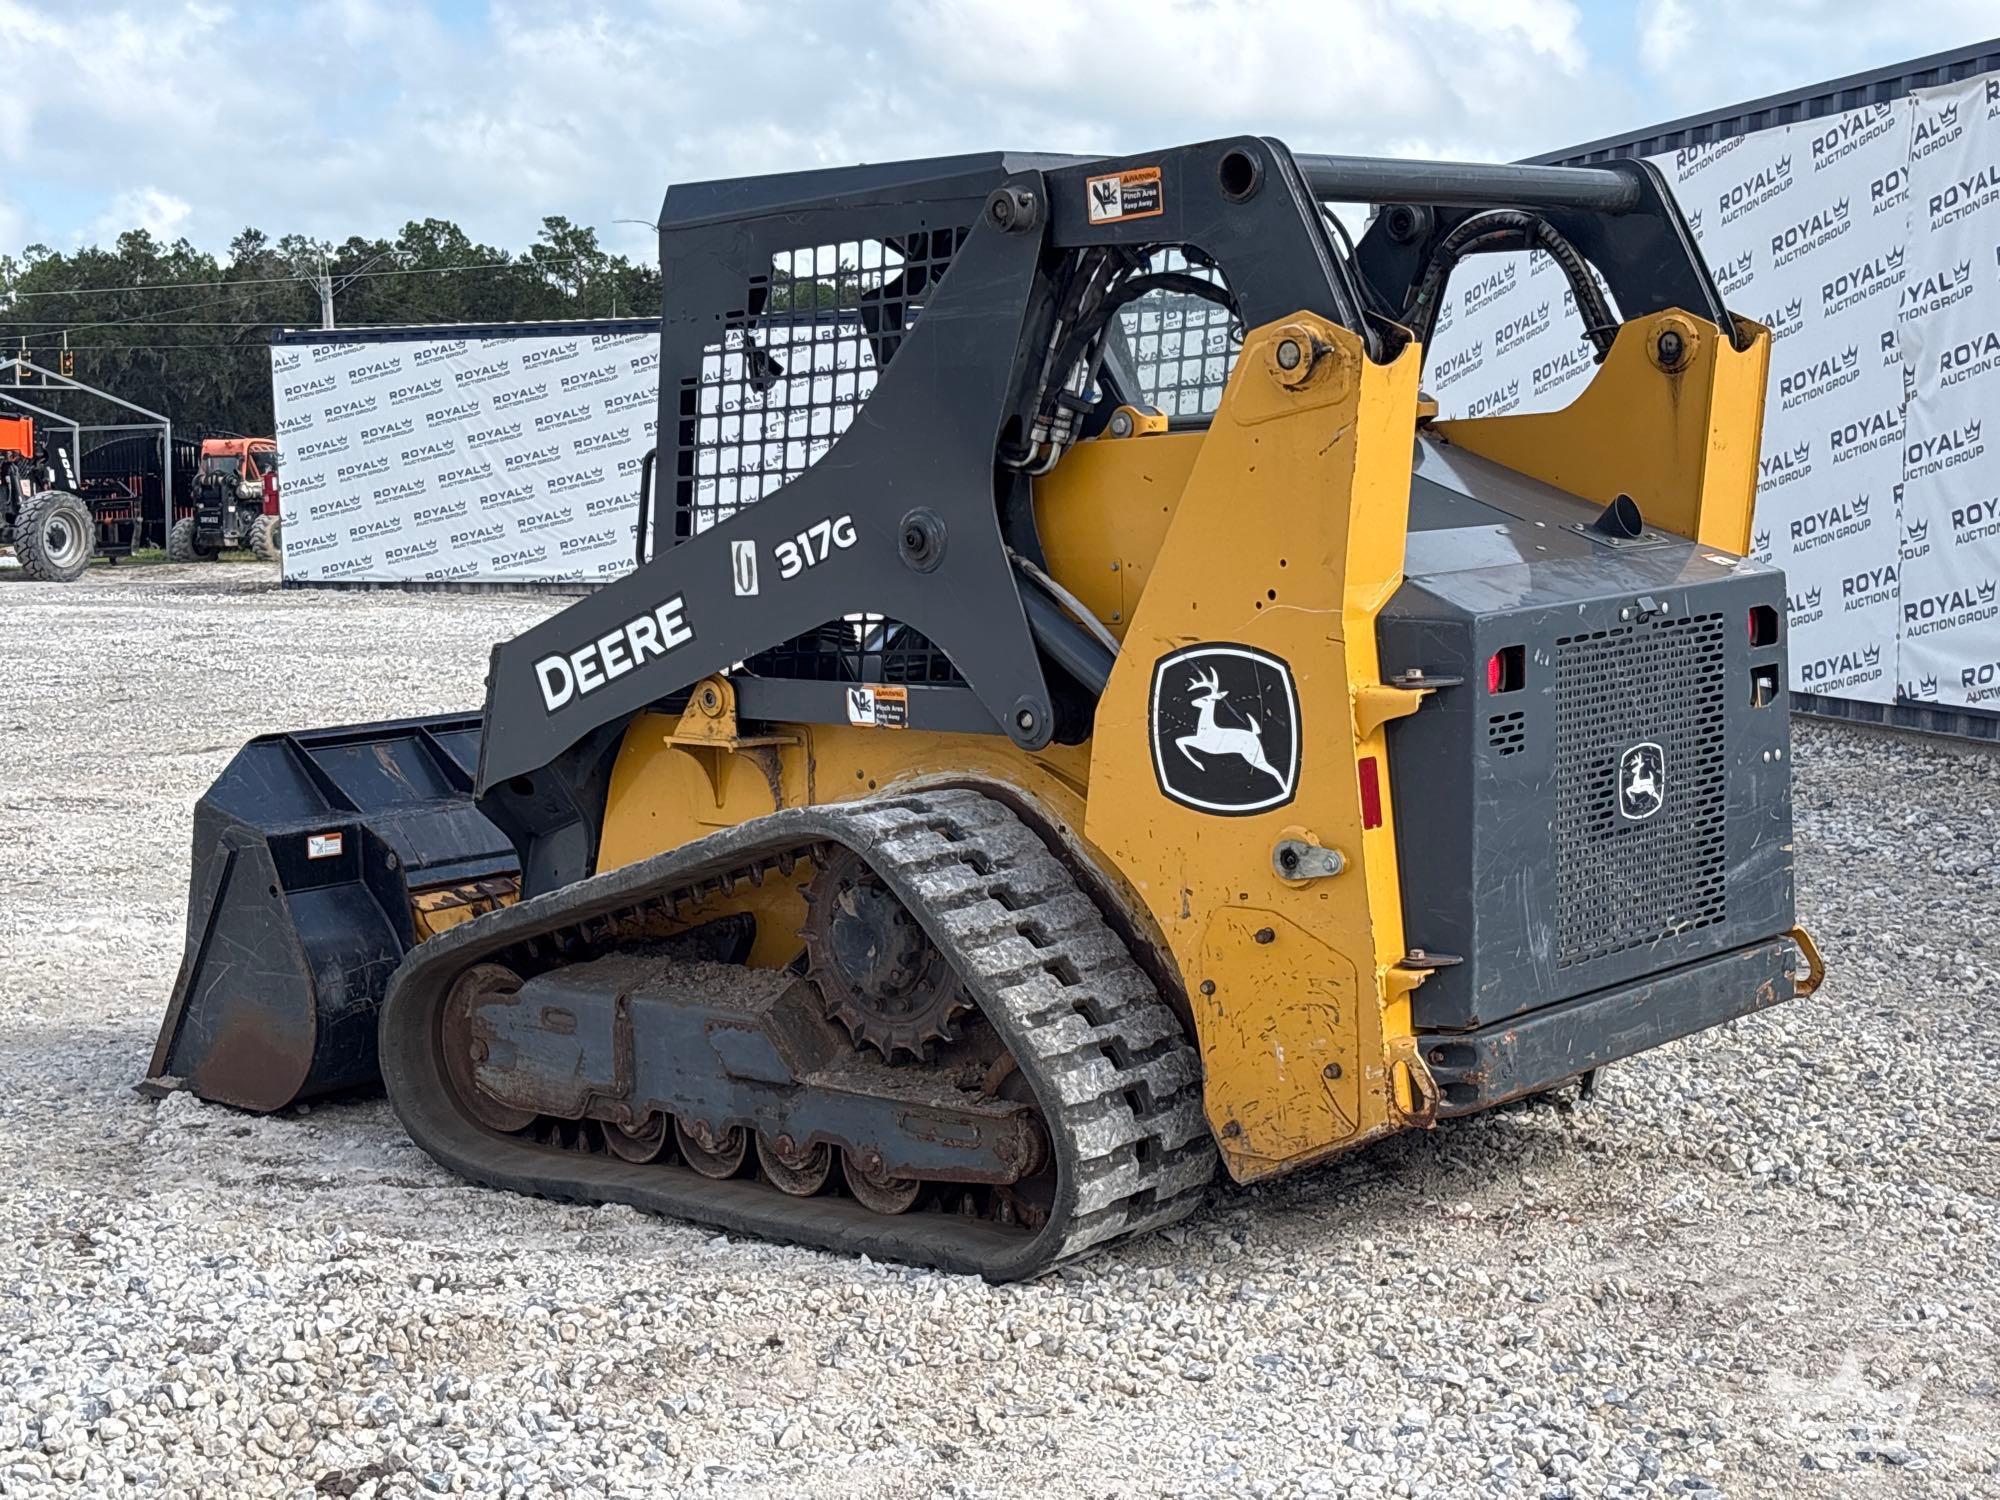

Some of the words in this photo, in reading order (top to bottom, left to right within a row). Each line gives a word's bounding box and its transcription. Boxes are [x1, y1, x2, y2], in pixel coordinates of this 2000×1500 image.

[1812, 110, 1875, 158] ROYAL
[1815, 140, 1857, 172] AUCTION
[1859, 118, 1894, 146] GROUP
[1923, 126, 1963, 156] GROUP
[1678, 154, 1714, 183] AUCTION
[1715, 135, 1745, 159] GROUP
[1719, 169, 1776, 213] ROYAL
[1722, 197, 1759, 227] AUCTION
[1761, 178, 1792, 203] GROUP
[1931, 198, 1980, 232] AUCTION
[1772, 211, 1833, 255] ROYAL
[1774, 240, 1815, 270] AUCTION
[1817, 221, 1852, 246] GROUP
[1464, 272, 1504, 306] ROYAL
[1723, 273, 1754, 296] GROUP
[1821, 259, 1886, 304] ROYAL
[1466, 294, 1492, 317] AUCTION
[1494, 280, 1516, 300] GROUP
[1824, 288, 1867, 318] AUCTION
[1869, 270, 1905, 295] GROUP
[1930, 285, 1973, 311] GROUP
[1495, 312, 1537, 346] ROYAL
[1497, 335, 1525, 357] AUCTION
[1526, 321, 1550, 340] GROUP
[414, 344, 456, 361] ROYAL
[522, 346, 566, 364] ROYAL
[630, 354, 659, 368] ROY
[1940, 332, 2000, 373] ROYA
[349, 362, 390, 379] ROYAL
[455, 365, 498, 382] ROYAL
[1436, 349, 1472, 381] ROYAL
[1436, 371, 1461, 392] AUCTION
[1462, 359, 1482, 377] GROUP
[1533, 351, 1577, 385] ROYAL
[1940, 359, 1991, 388] AUCTION
[285, 380, 325, 396] ROYAL
[561, 369, 605, 387] ROYAL
[1534, 374, 1564, 397] AUCTION
[1566, 361, 1590, 380] GROUP
[1780, 357, 1842, 397] ROYAL
[389, 383, 431, 400] ROYAL
[493, 388, 536, 405] ROYAL
[605, 390, 650, 408] ROYAL
[1783, 385, 1824, 411] AUCTION
[1826, 369, 1860, 392] GROUP
[325, 400, 365, 417] ROYAL
[426, 405, 468, 422] ROYAL
[1468, 387, 1508, 419] ROYAL
[535, 409, 579, 426] ROYAL
[361, 423, 402, 439] ROYAL
[468, 427, 510, 444] ROYAL
[574, 432, 618, 449] ROYAL
[1830, 410, 1897, 450] ROYAL
[298, 440, 338, 456] ROYAL
[402, 444, 443, 460] ROYAL
[505, 449, 548, 466] ROYAL
[1833, 439, 1877, 465] AUCTION
[1904, 430, 1964, 466] OYAL
[337, 461, 378, 477] ROYAL
[438, 466, 480, 483] ROYAL
[1903, 460, 1943, 482] UCTION
[1946, 445, 1984, 468] GROUP
[548, 472, 592, 488] ROYAL
[1778, 465, 1812, 485] GROUP
[373, 483, 414, 499] ROYAL
[480, 488, 523, 505] ROYAL
[310, 499, 350, 515] ROYAL
[414, 505, 455, 521] ROYAL
[586, 494, 630, 511] ROYAL
[350, 521, 390, 536] ROYAL
[518, 511, 561, 528] ROYAL
[1790, 504, 1852, 540] ROYAL
[287, 536, 326, 552] ROYAL
[451, 528, 493, 544] ROYAL
[560, 534, 604, 550] ROYAL
[774, 515, 857, 578] 317G
[1794, 531, 1834, 554] AUCTION
[1837, 519, 1871, 539] GROUP
[385, 543, 426, 559] ROYAL
[492, 550, 535, 566] ROYAL
[322, 558, 362, 574] ROYAL
[425, 566, 466, 580] ROYAL
[1842, 565, 1898, 597] ROYA
[1845, 590, 1889, 612] AUCTION
[1904, 589, 1977, 623] ROYAL
[1791, 610, 1823, 628] GROUP
[1907, 617, 1955, 638] AUCTION
[1958, 606, 1999, 625] GROUP
[535, 596, 692, 712] DEERE
[1802, 652, 1862, 682] ROYAL
[1804, 677, 1845, 695] AUCTION
[1847, 669, 1882, 686] GROUP
